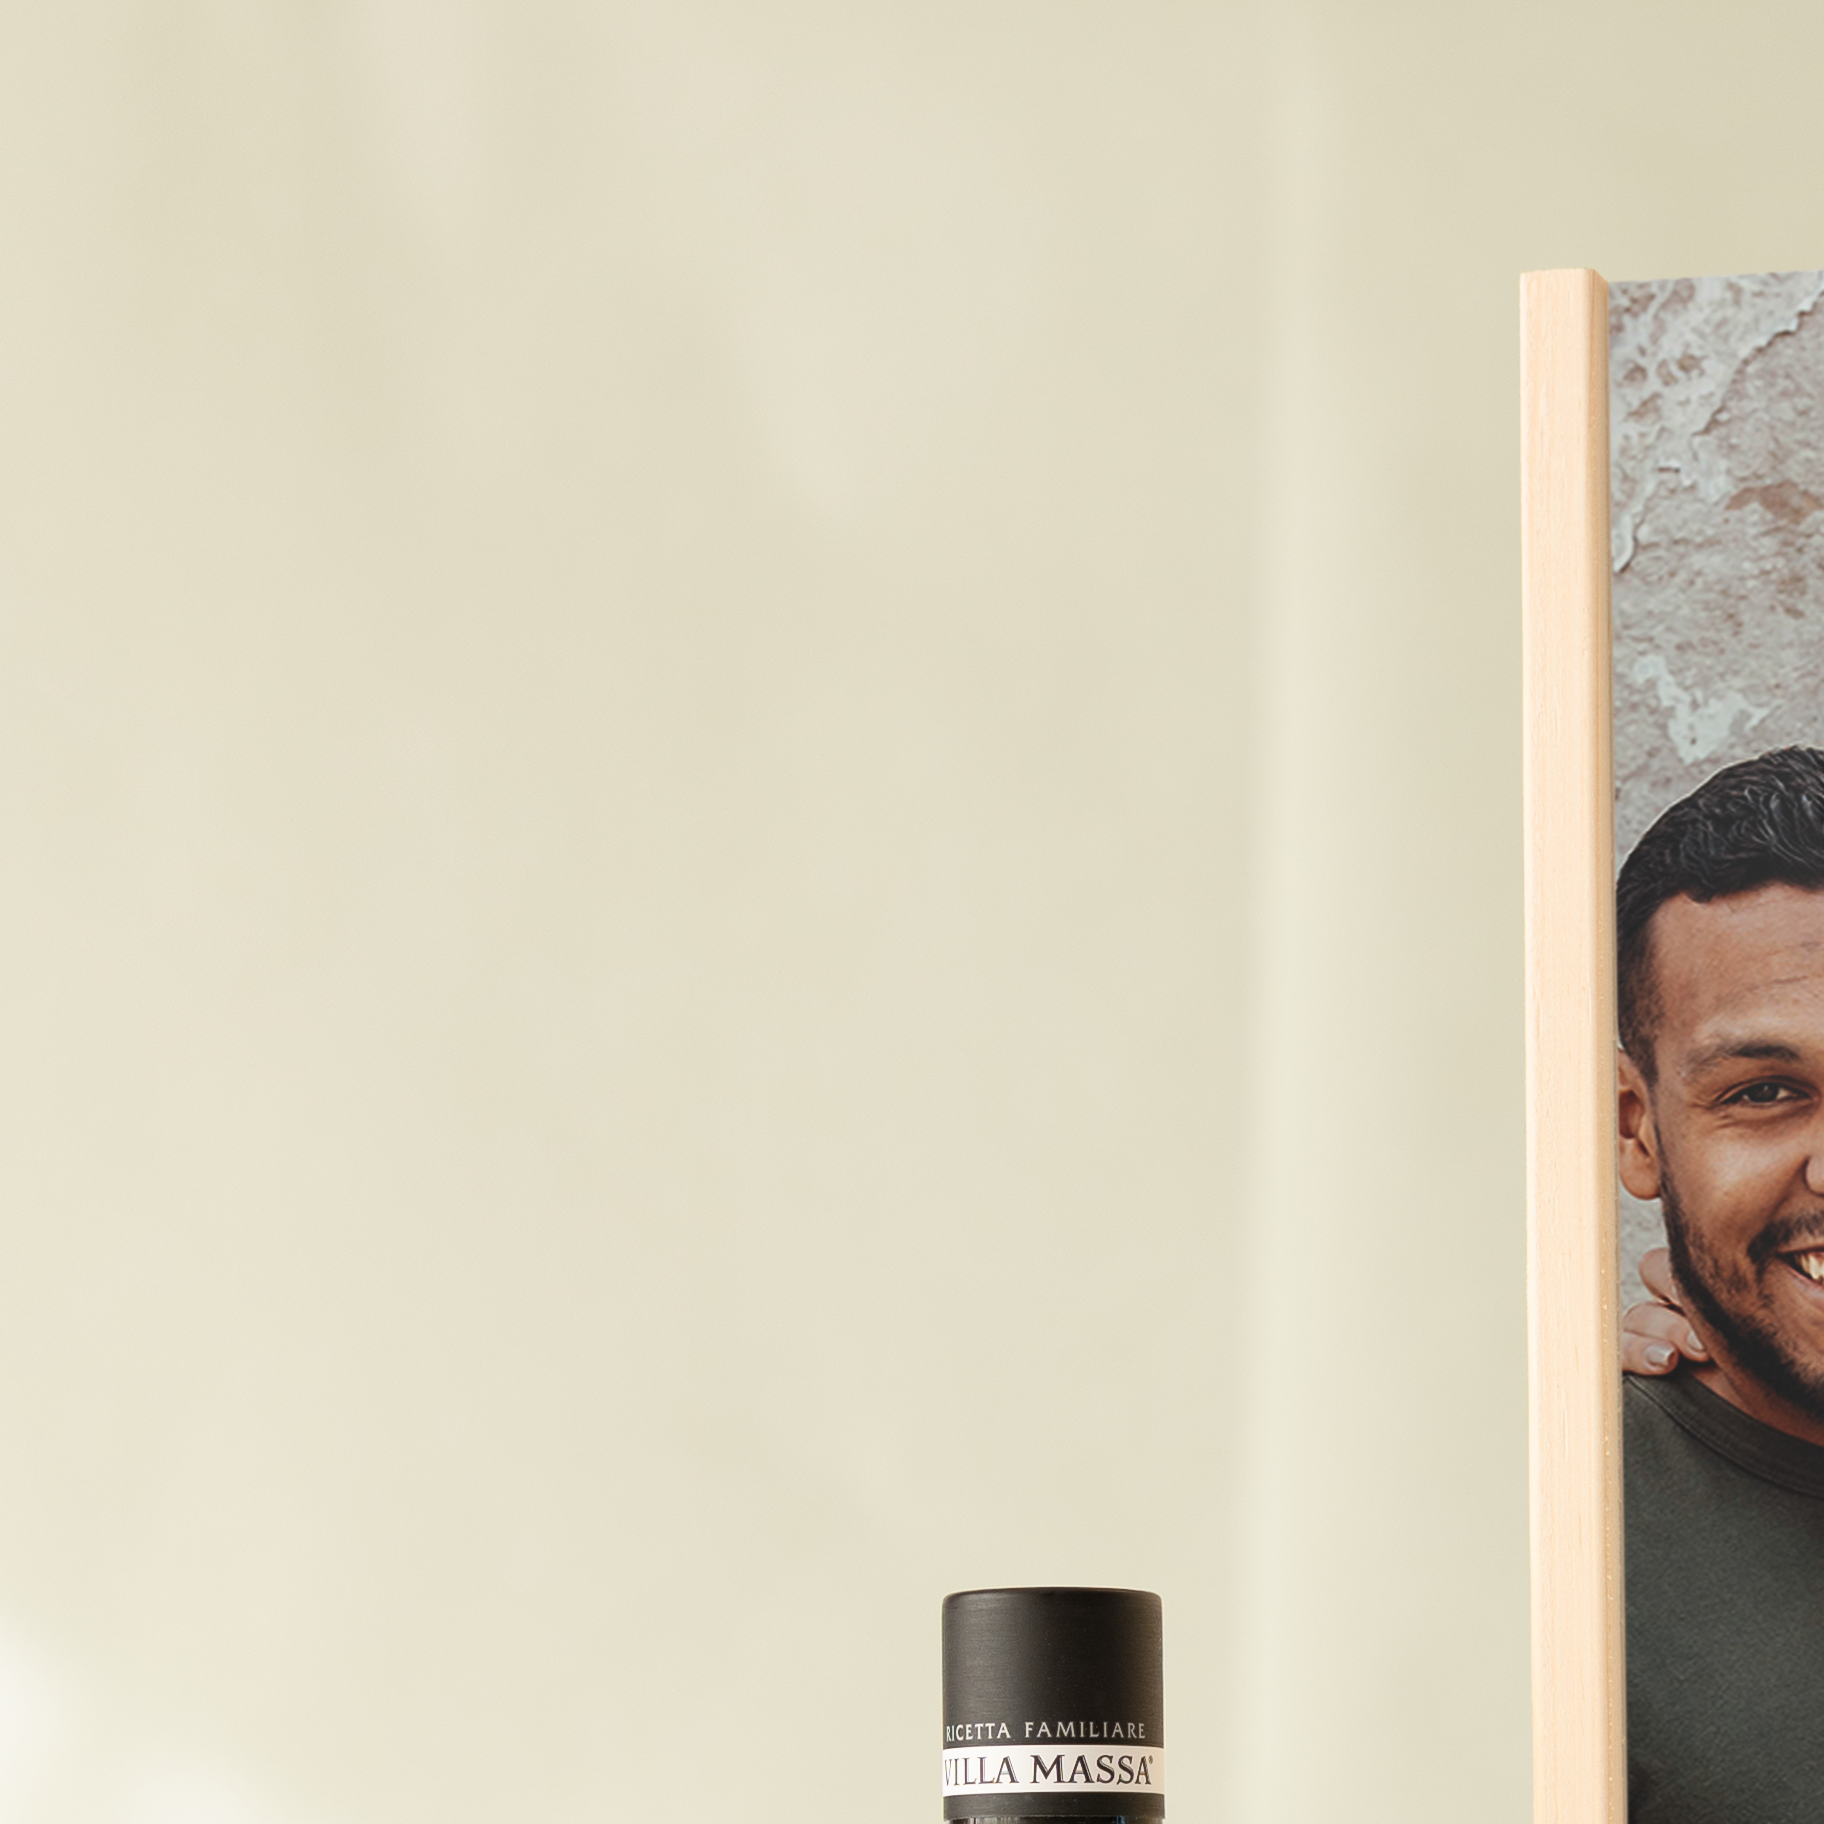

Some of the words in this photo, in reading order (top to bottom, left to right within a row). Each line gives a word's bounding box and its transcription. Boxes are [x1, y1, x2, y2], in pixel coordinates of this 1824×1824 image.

[946, 1722, 1011, 1743] RICETTA
[1023, 1720, 1146, 1740] FAMILIARE
[944, 1755, 1020, 1787] VILLA
